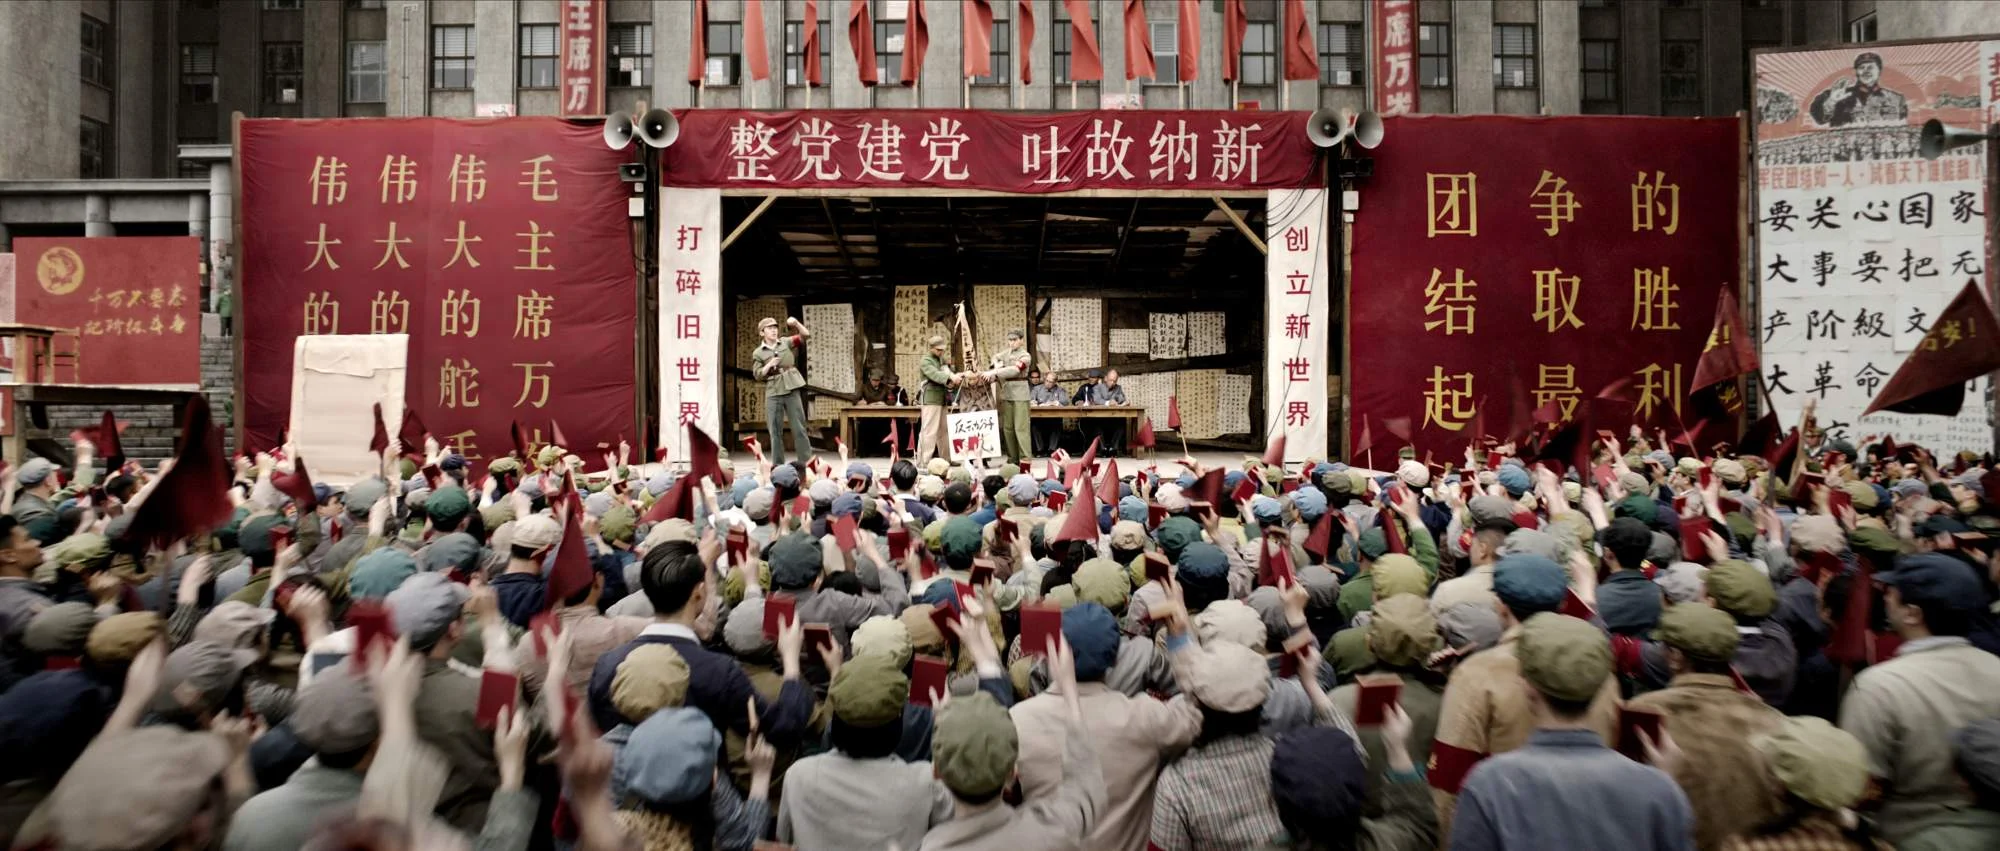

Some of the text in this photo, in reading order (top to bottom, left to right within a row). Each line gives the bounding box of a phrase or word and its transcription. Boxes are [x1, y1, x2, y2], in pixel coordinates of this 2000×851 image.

[1384, 1, 1412, 115] 席万岁
[727, 117, 1264, 183] 整党建党 吐故纳新
[1760, 190, 1985, 232] 要关心国家
[303, 155, 348, 335] 伟大的
[371, 154, 418, 334] 伟大的
[676, 225, 702, 427] 打碎旧世界
[1285, 226, 1311, 427] 创立新世界
[1422, 172, 1478, 431] 团结起
[1530, 170, 1585, 430] 争取最
[1630, 170, 1682, 418] 的胜利
[1765, 248, 1983, 287] 大事要把无
